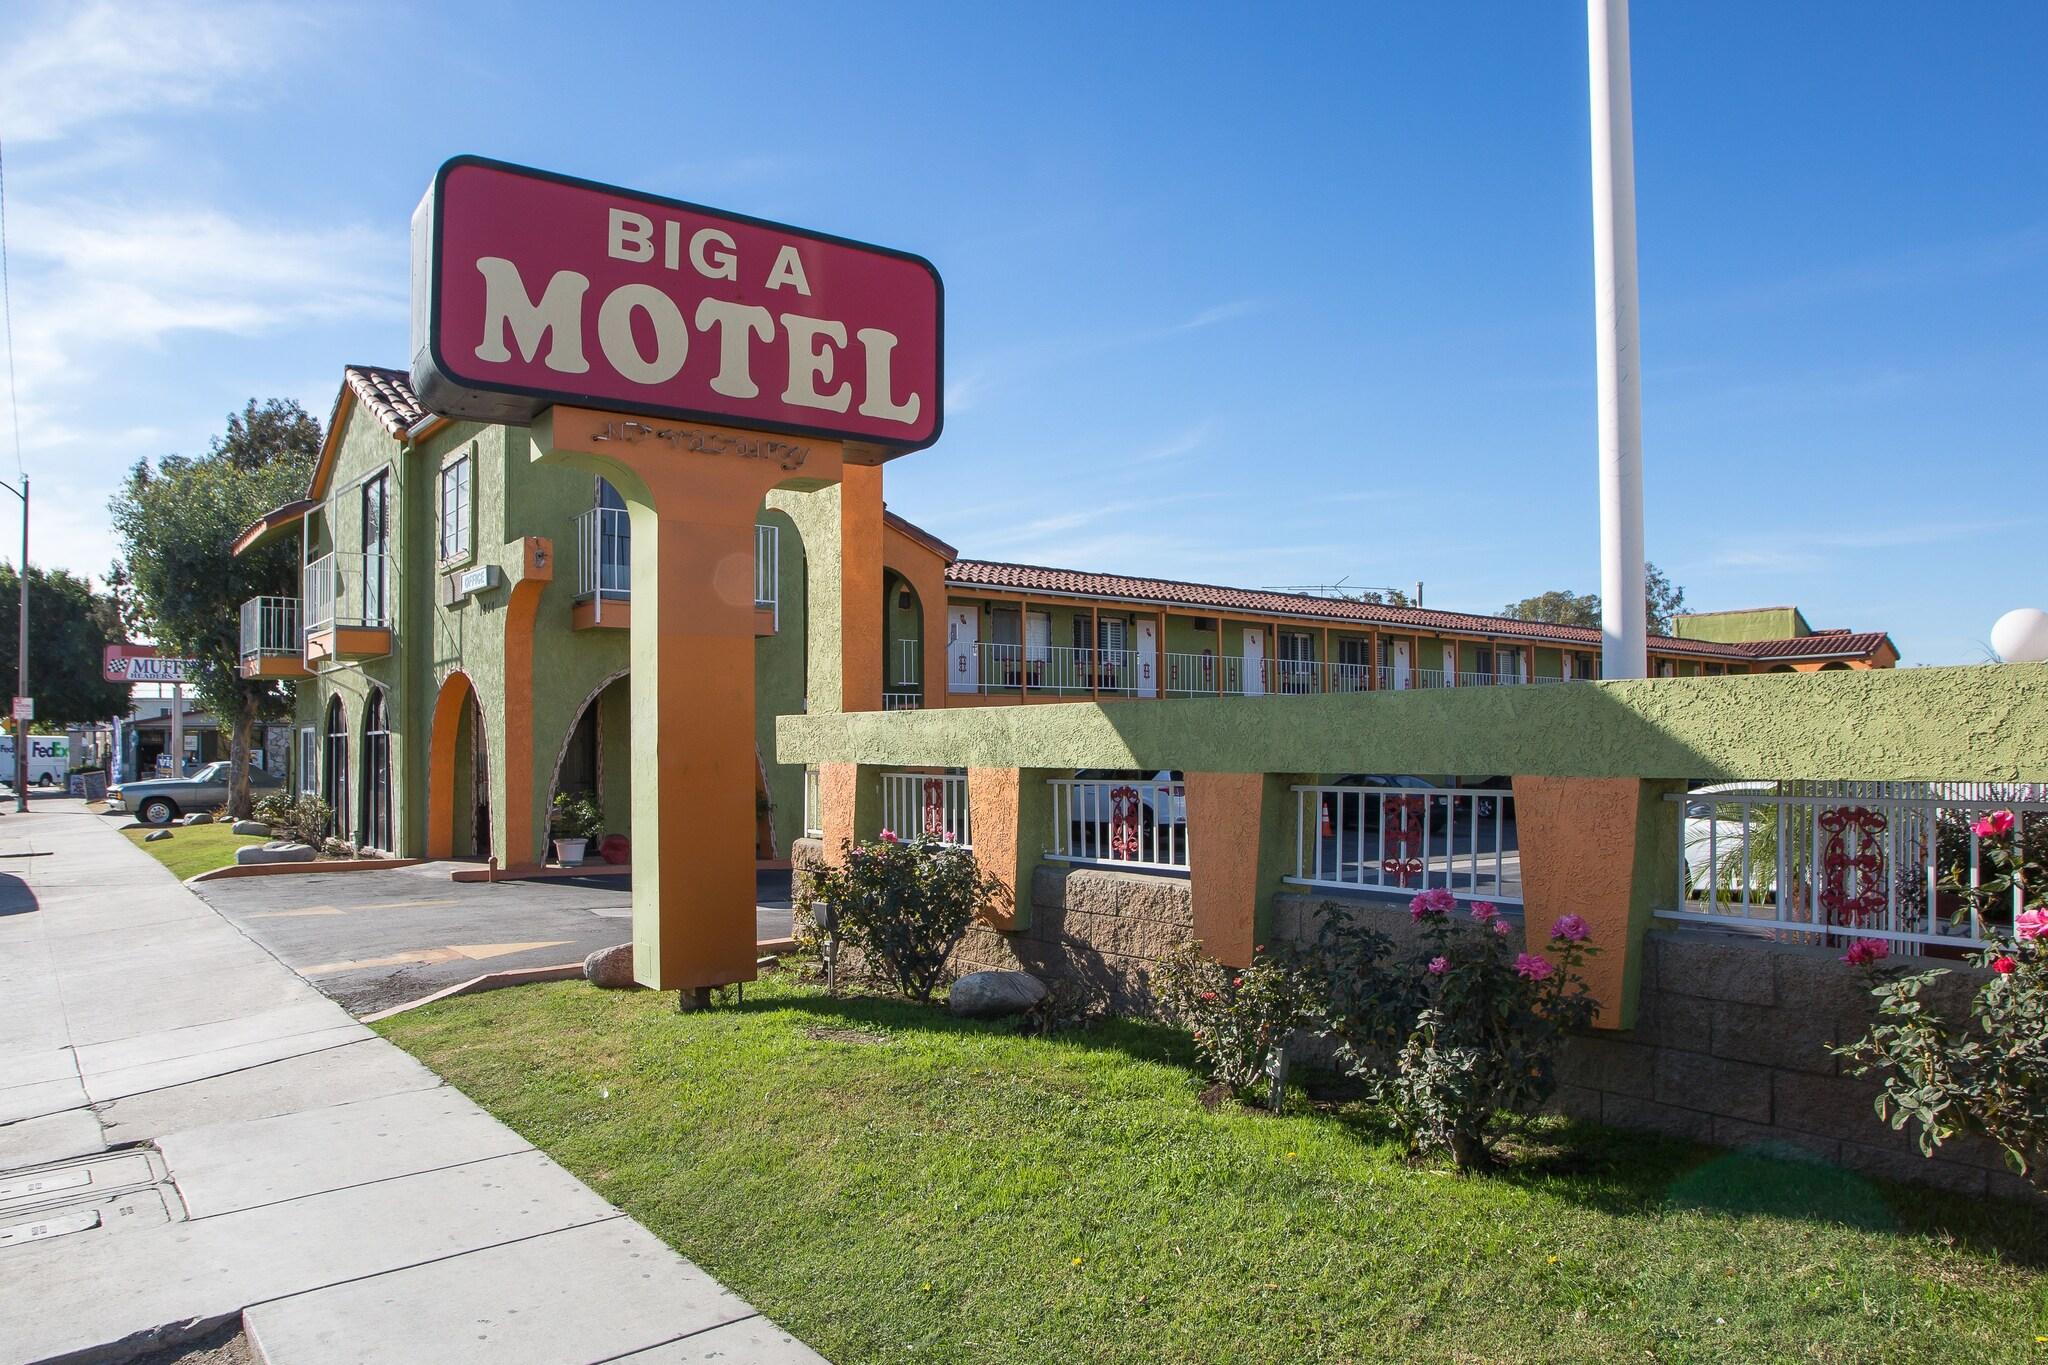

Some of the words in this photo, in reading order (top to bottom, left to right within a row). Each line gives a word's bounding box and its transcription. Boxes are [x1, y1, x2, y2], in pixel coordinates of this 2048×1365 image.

[607, 207, 738, 281] BIG
[764, 245, 812, 296] A
[474, 256, 921, 425] MOTEL
[134, 659, 204, 674] MUFF
[32, 741, 68, 758] FedEx
